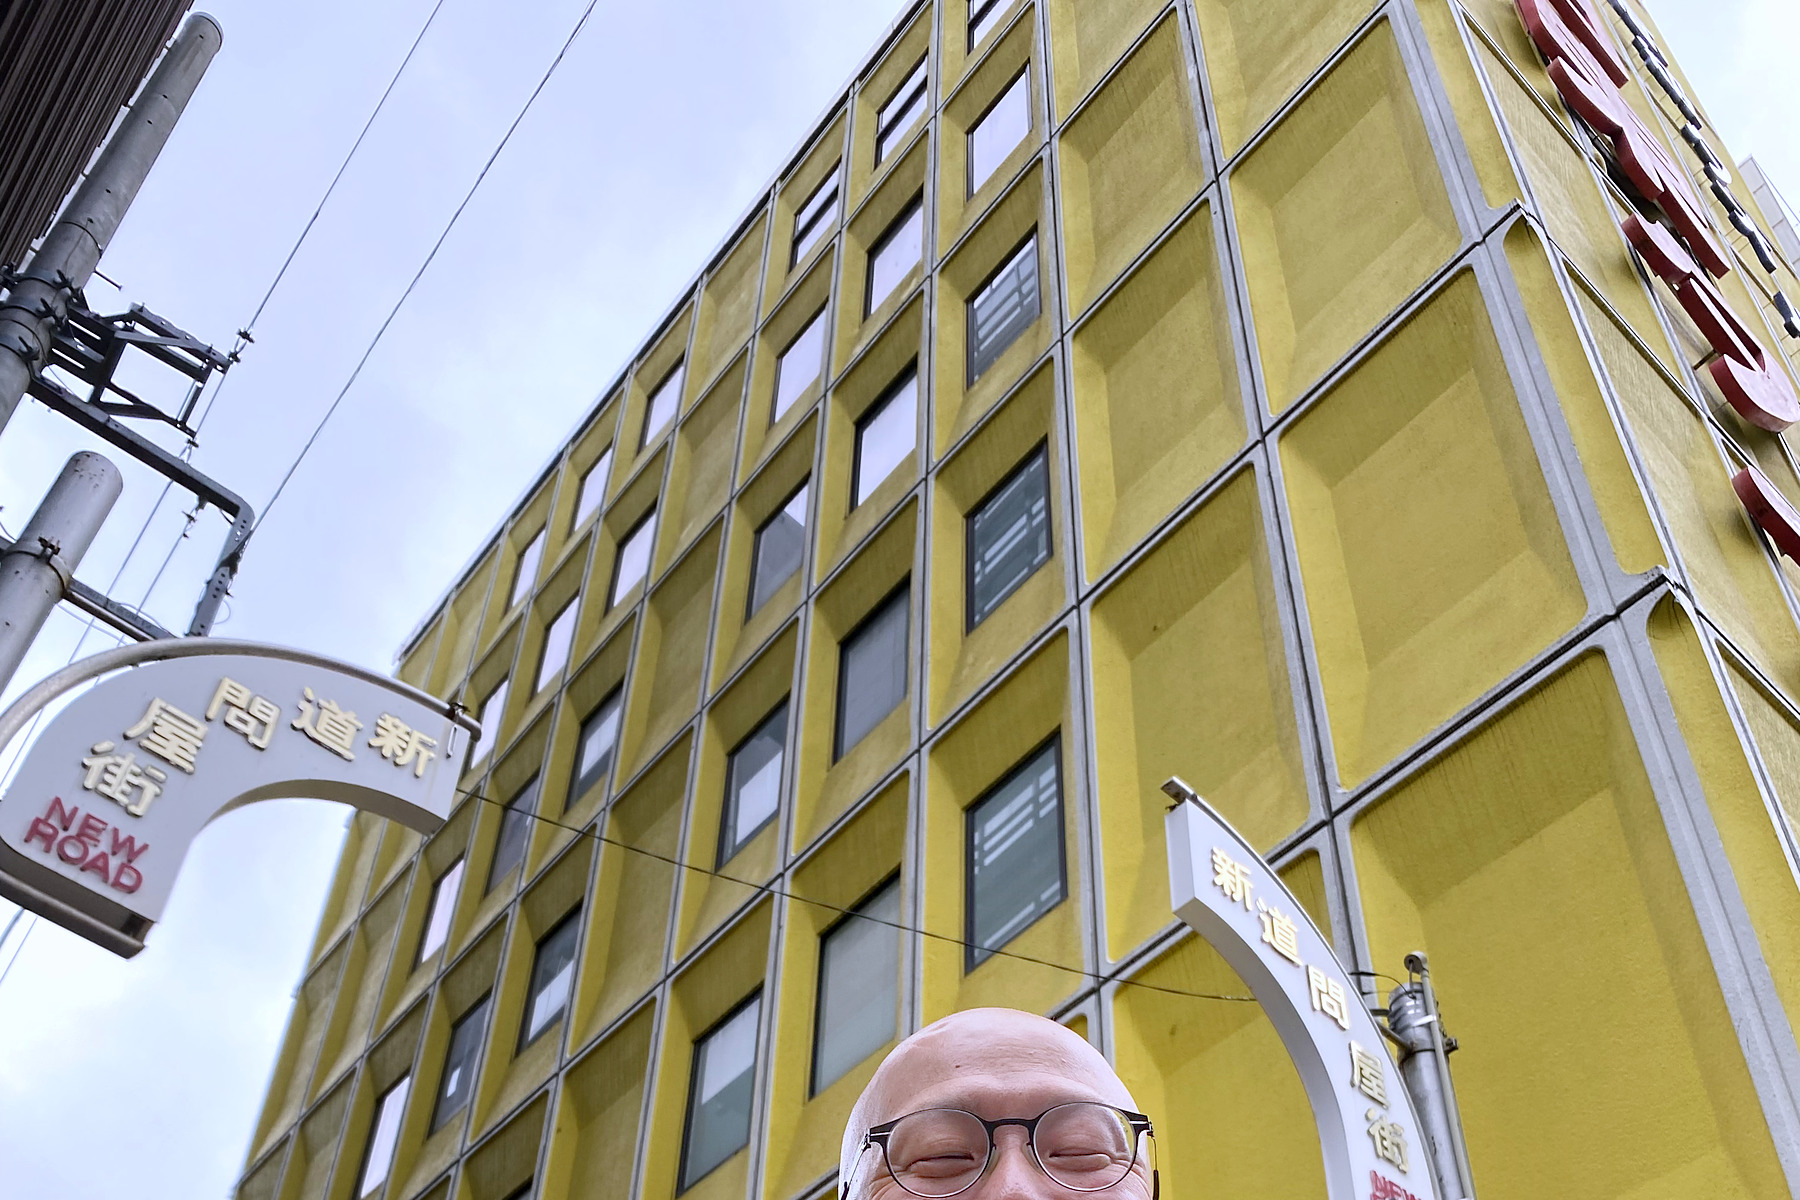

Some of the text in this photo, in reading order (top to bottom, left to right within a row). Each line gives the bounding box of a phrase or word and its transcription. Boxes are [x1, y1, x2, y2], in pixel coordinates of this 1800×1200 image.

[81, 676, 438, 817] 新道問屋街
[24, 817, 144, 893] ROAD
[43, 796, 150, 862] NEW
[1211, 846, 1410, 1173] 新道問屋街
